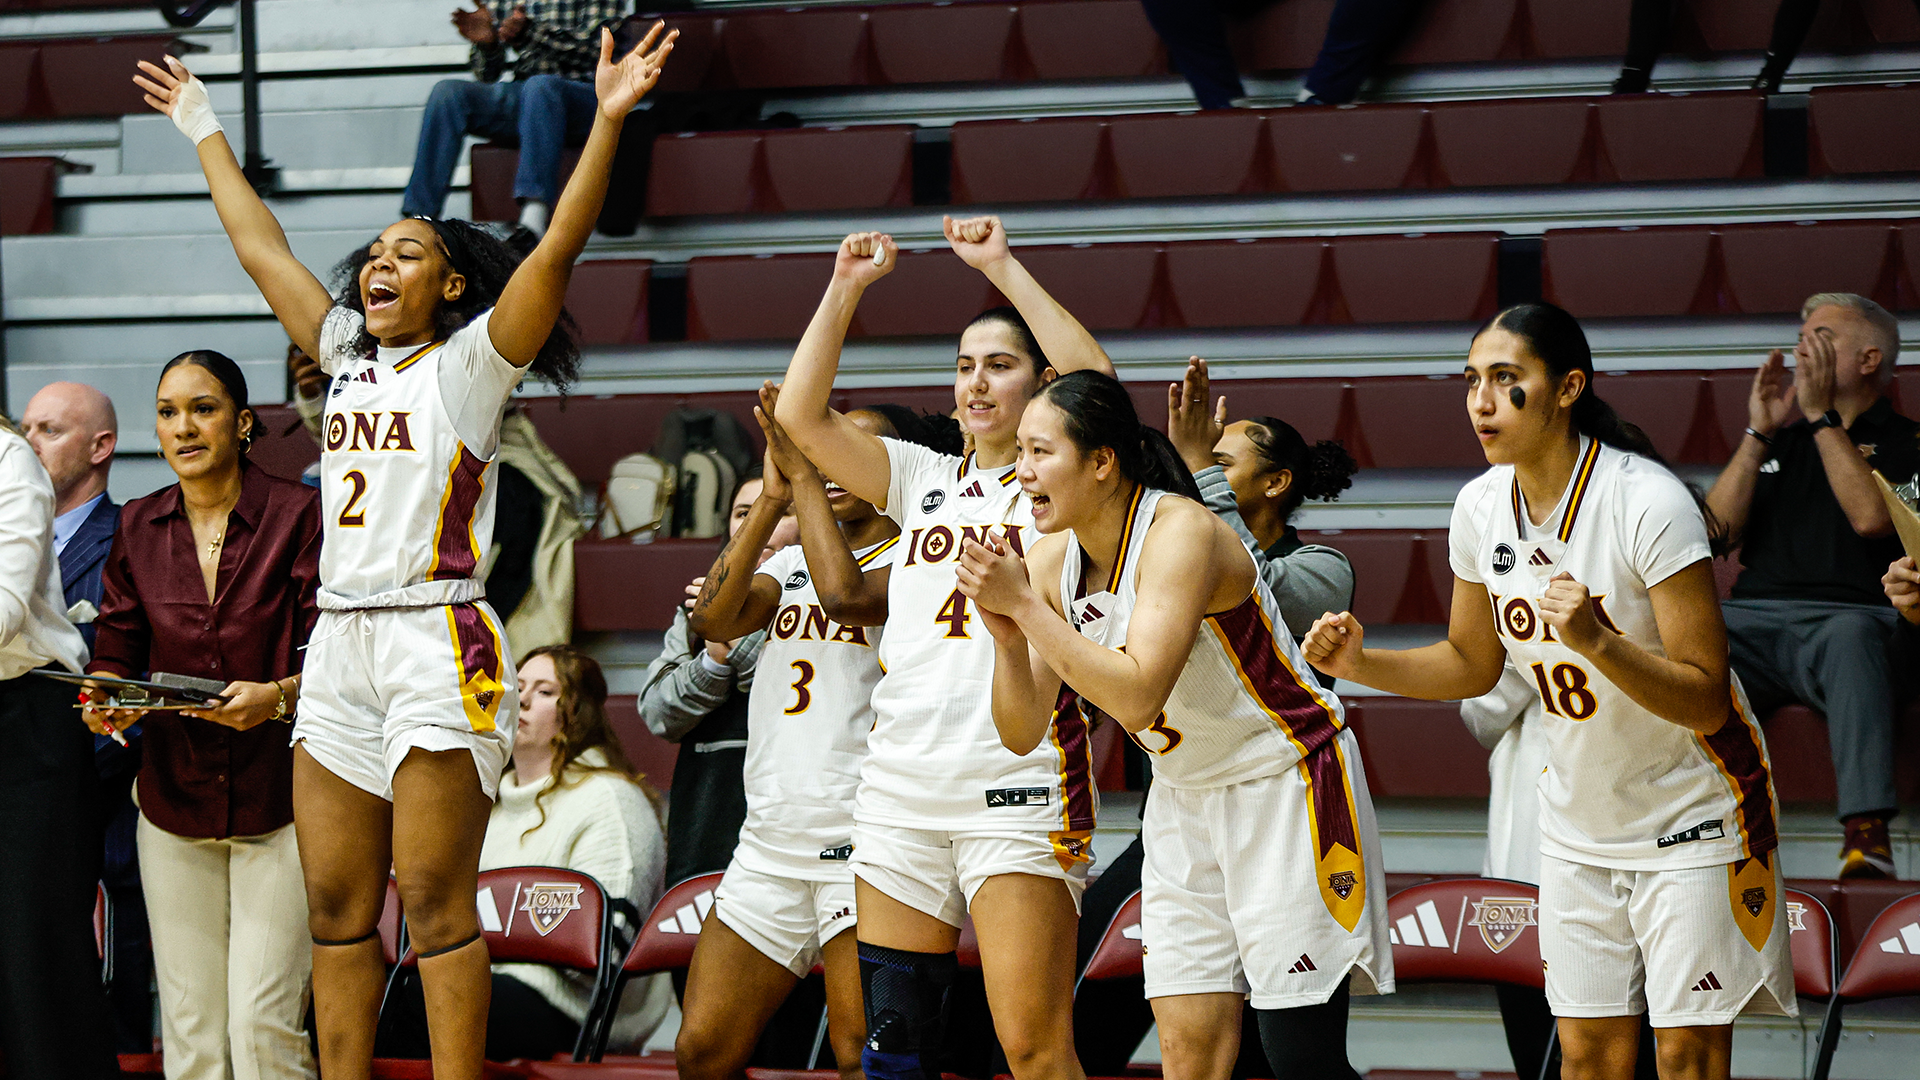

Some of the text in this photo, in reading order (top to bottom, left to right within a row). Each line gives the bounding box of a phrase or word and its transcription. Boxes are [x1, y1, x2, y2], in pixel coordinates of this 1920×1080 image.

[338, 469, 368, 528] 2
[922, 495, 943, 507] BLM
[1493, 552, 1512, 566] BLM
[934, 586, 972, 640] 4
[783, 658, 816, 716] 3
[1530, 661, 1599, 722] 18
[527, 892, 575, 907] IONA
[1476, 906, 1532, 924] IONA
